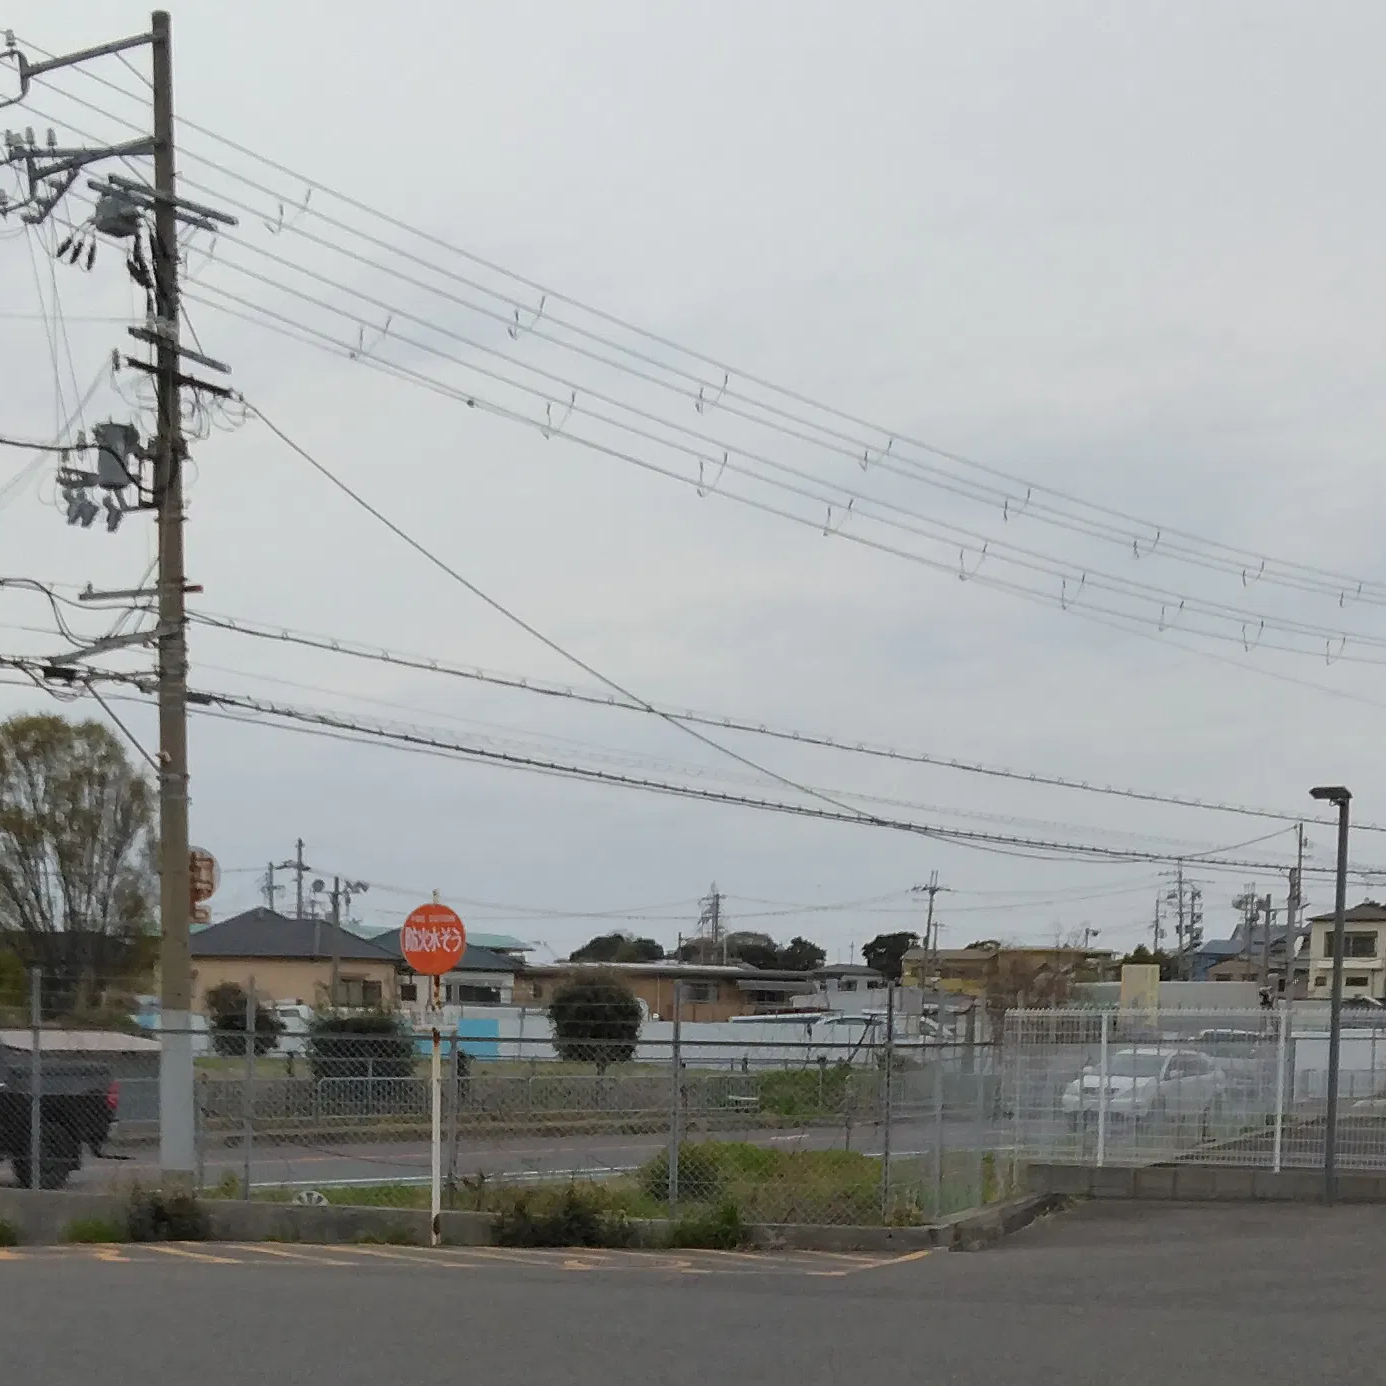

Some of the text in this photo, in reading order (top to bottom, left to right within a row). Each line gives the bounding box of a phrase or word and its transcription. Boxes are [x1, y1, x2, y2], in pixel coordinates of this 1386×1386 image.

[405, 926, 461, 953] 防火水そう
